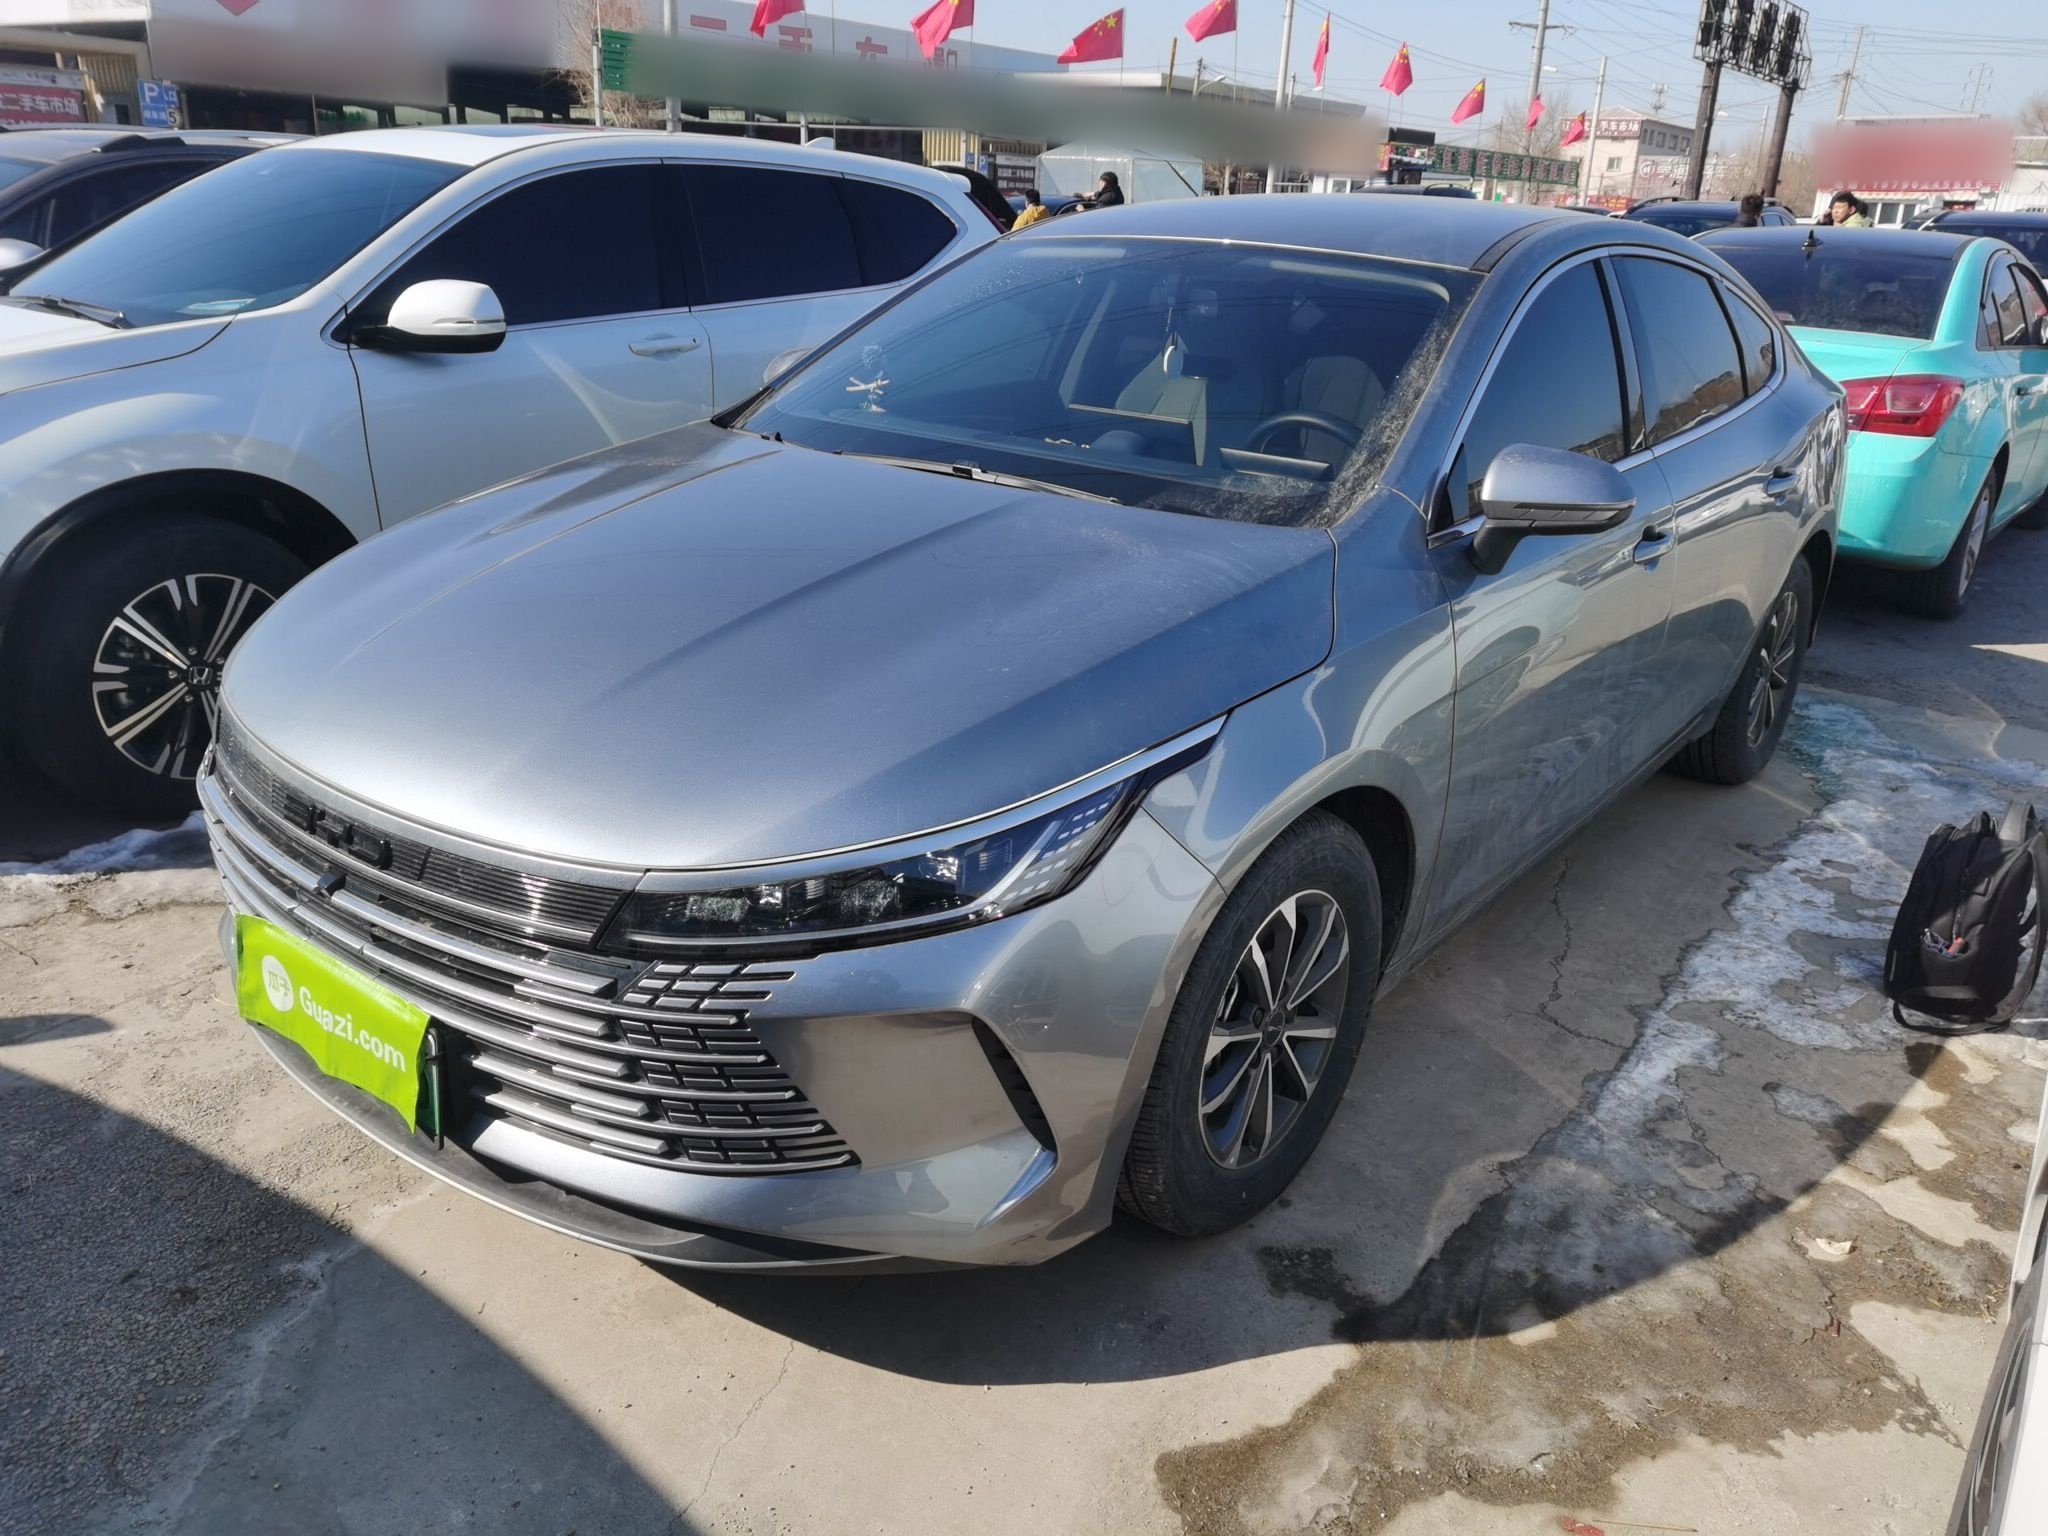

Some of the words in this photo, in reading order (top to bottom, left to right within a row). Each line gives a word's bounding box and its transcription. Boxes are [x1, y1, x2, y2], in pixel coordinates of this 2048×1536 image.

[144, 82, 159, 103] P
[168, 112, 177, 124] 5
[299, 986, 407, 1073] Guazi.com
